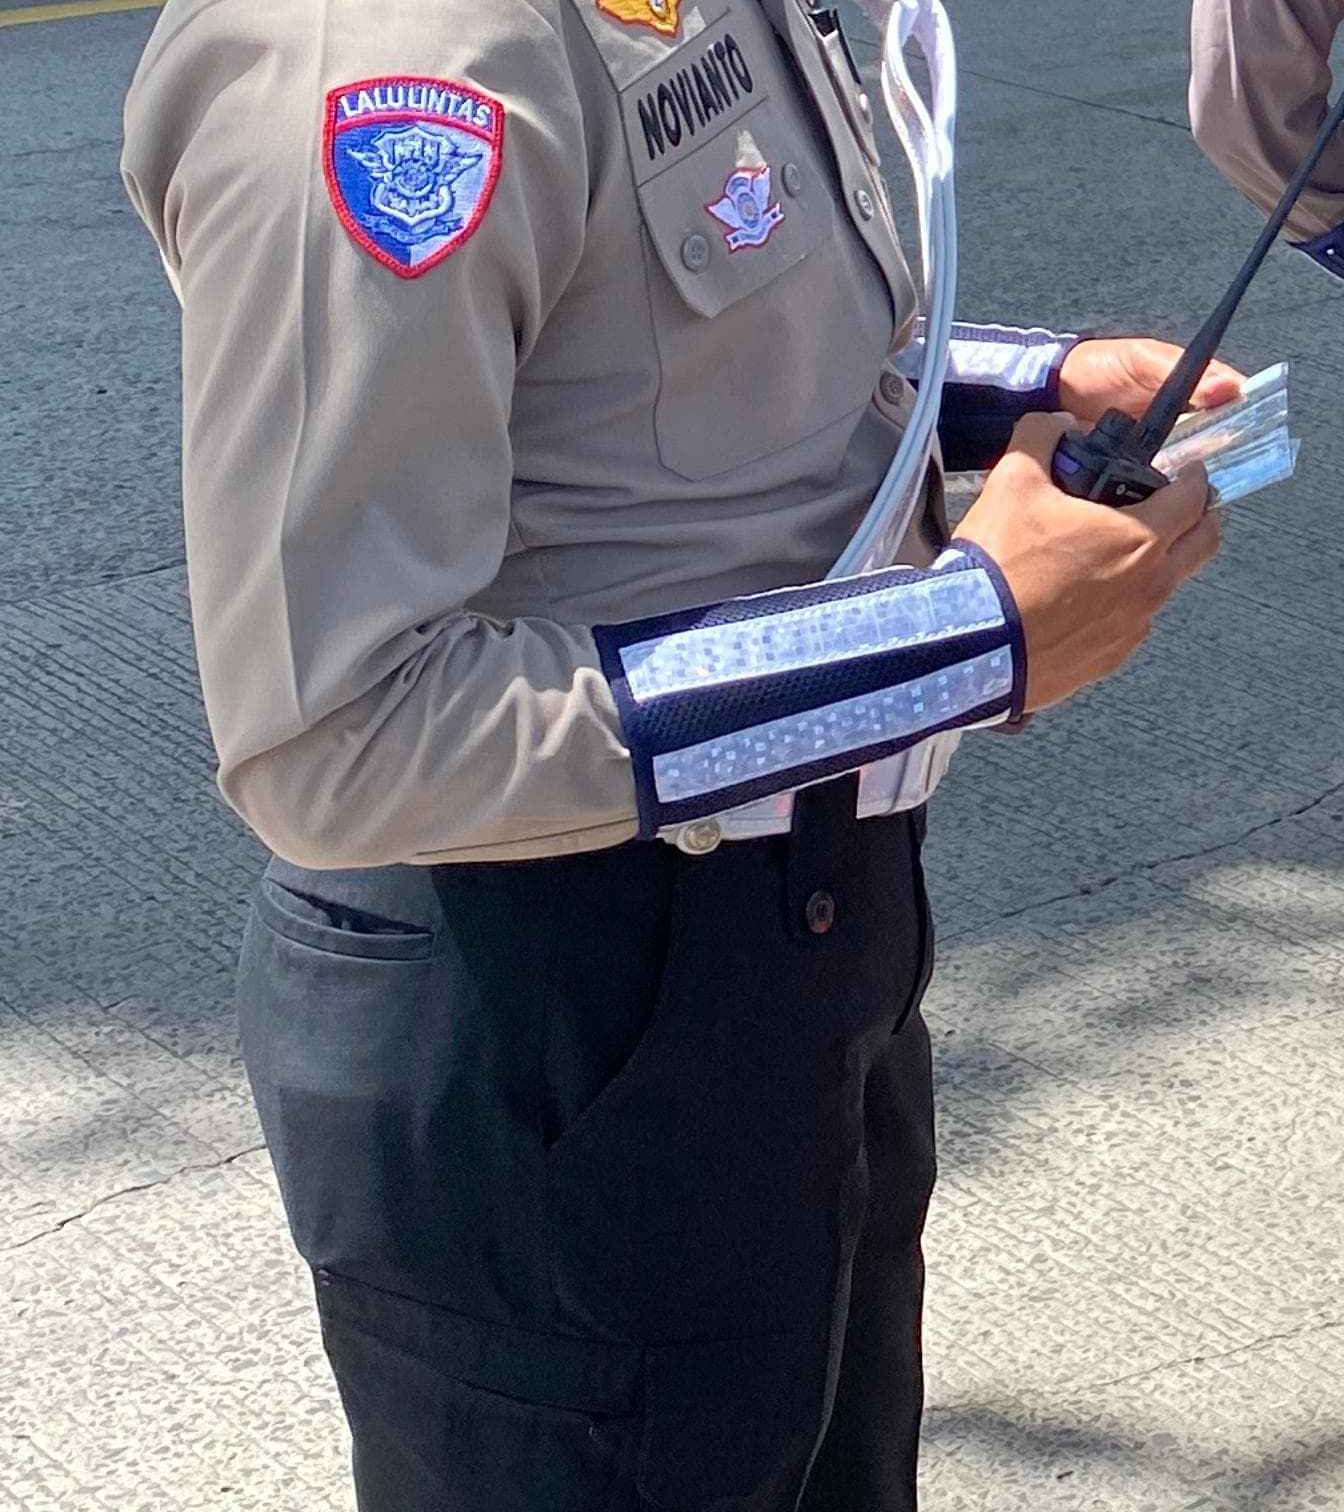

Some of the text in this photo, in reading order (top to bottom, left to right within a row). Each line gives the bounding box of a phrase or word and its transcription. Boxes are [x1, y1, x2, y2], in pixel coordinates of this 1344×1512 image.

[340, 86, 492, 127] LALU LINTAS
[637, 33, 754, 161] NOVIANTO
